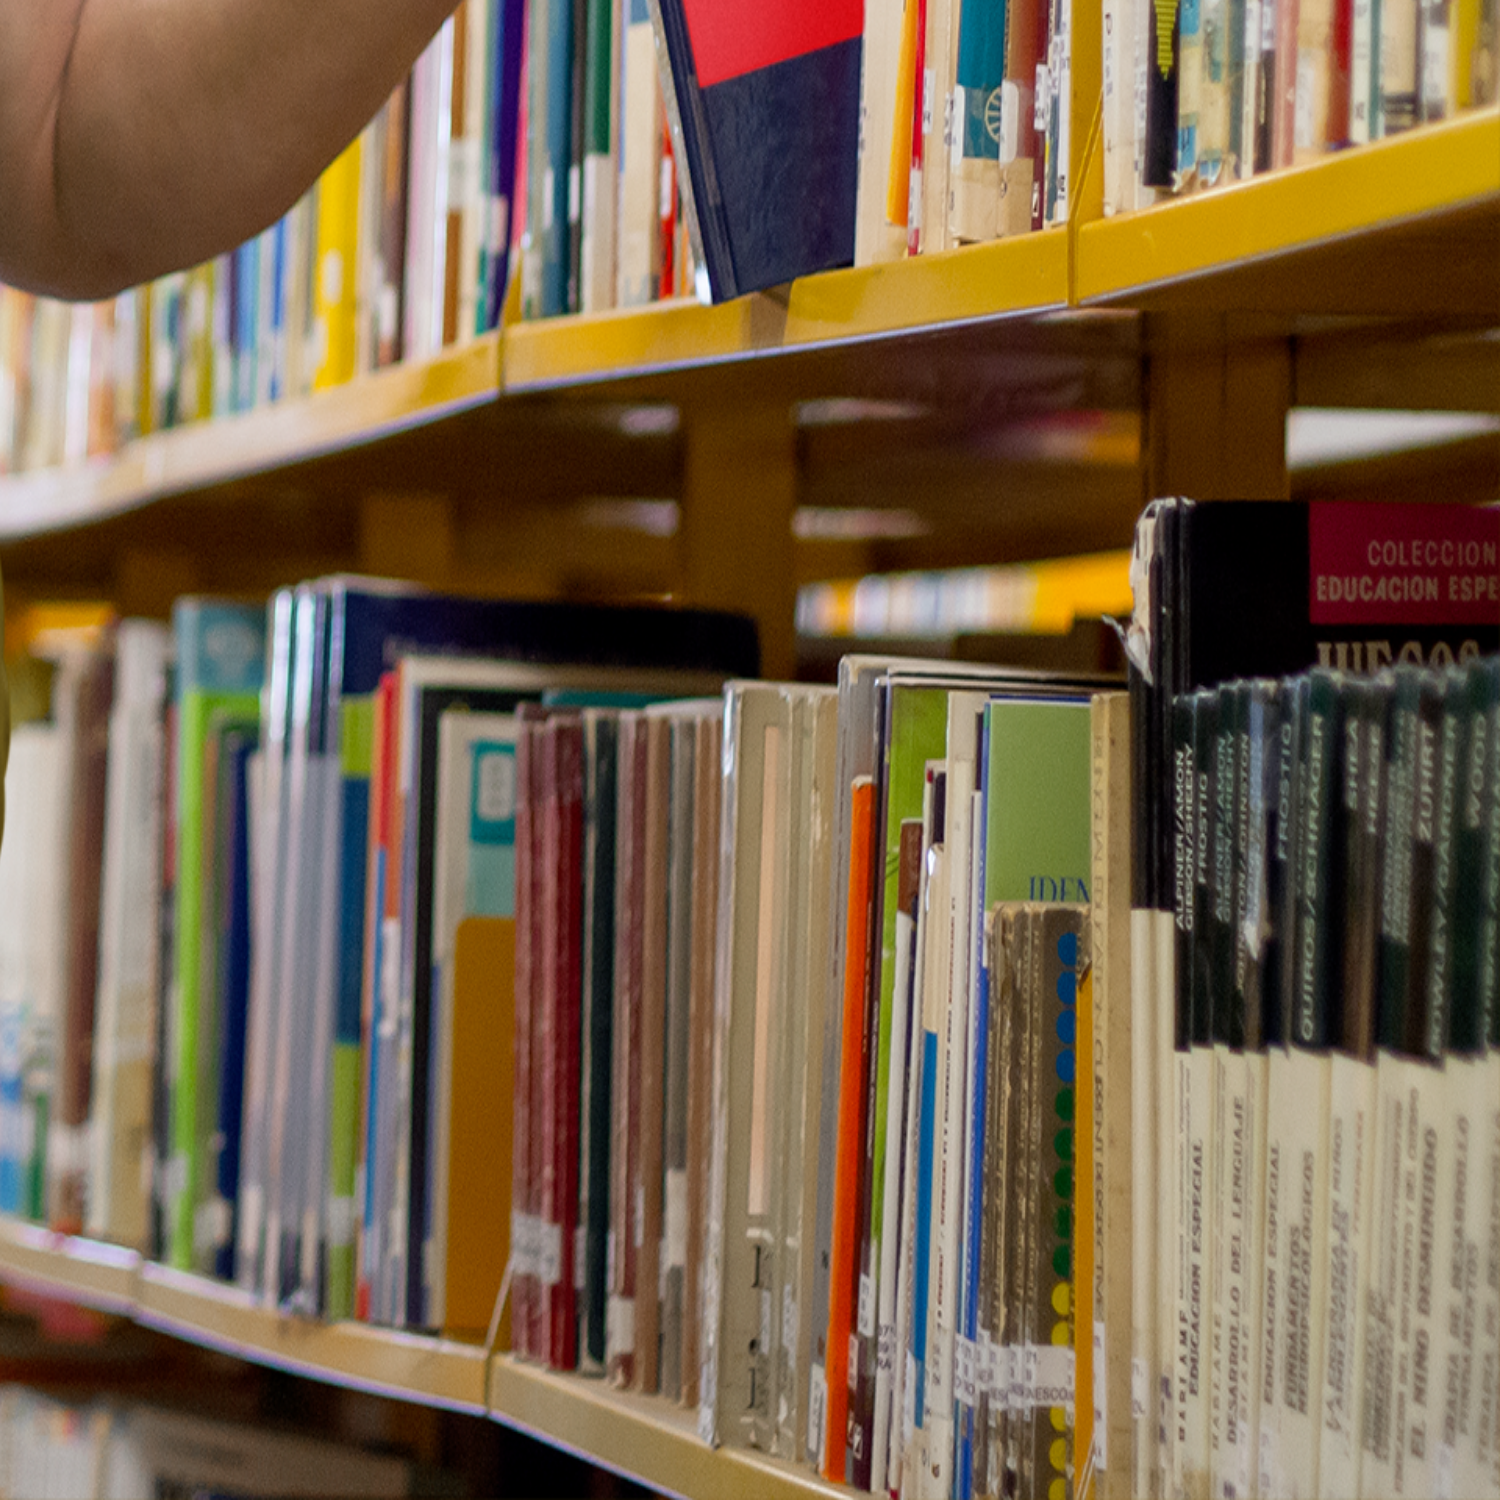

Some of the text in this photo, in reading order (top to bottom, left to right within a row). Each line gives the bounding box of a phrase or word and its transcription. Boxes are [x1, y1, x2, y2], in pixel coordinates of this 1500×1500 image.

[1317, 575, 1439, 602] EDUCACION
[1367, 540, 1497, 567] COLECCION
[1175, 749, 1184, 931] ALPINER/AMON
[1184, 742, 1193, 931] GIBSON/SHEEHY
[1197, 771, 1208, 885] FROSTIG
[1278, 722, 1292, 861] FROSTIG
[1346, 718, 1359, 810] SHEA
[1418, 720, 1434, 843] ZUHRT
[1465, 712, 1487, 829] WOOD
[1093, 875, 1104, 1031] EDUCATION
[1302, 715, 1324, 1041] QUIROS/SCHRAGER
[1095, 1039, 1104, 1157] CURRENT
[1189, 1138, 1203, 1396] EDUCACION ESPECIAL
[1227, 1096, 1244, 1446] DESARROLLO DEL LENGUAJE
[1264, 1140, 1279, 1405] EDUCACION ESPECIAL
[1298, 1150, 1314, 1416] NEUROPSICOLOGICOS
[1330, 1198, 1341, 1232] EN
[1416, 1127, 1438, 1318] DISMINUIDO
[1442, 1114, 1469, 1449] ERAPIA DE DESARROLLO
[1285, 1223, 1300, 1411] FUNDAMENTOS
[1410, 1420, 1426, 1461] EL
